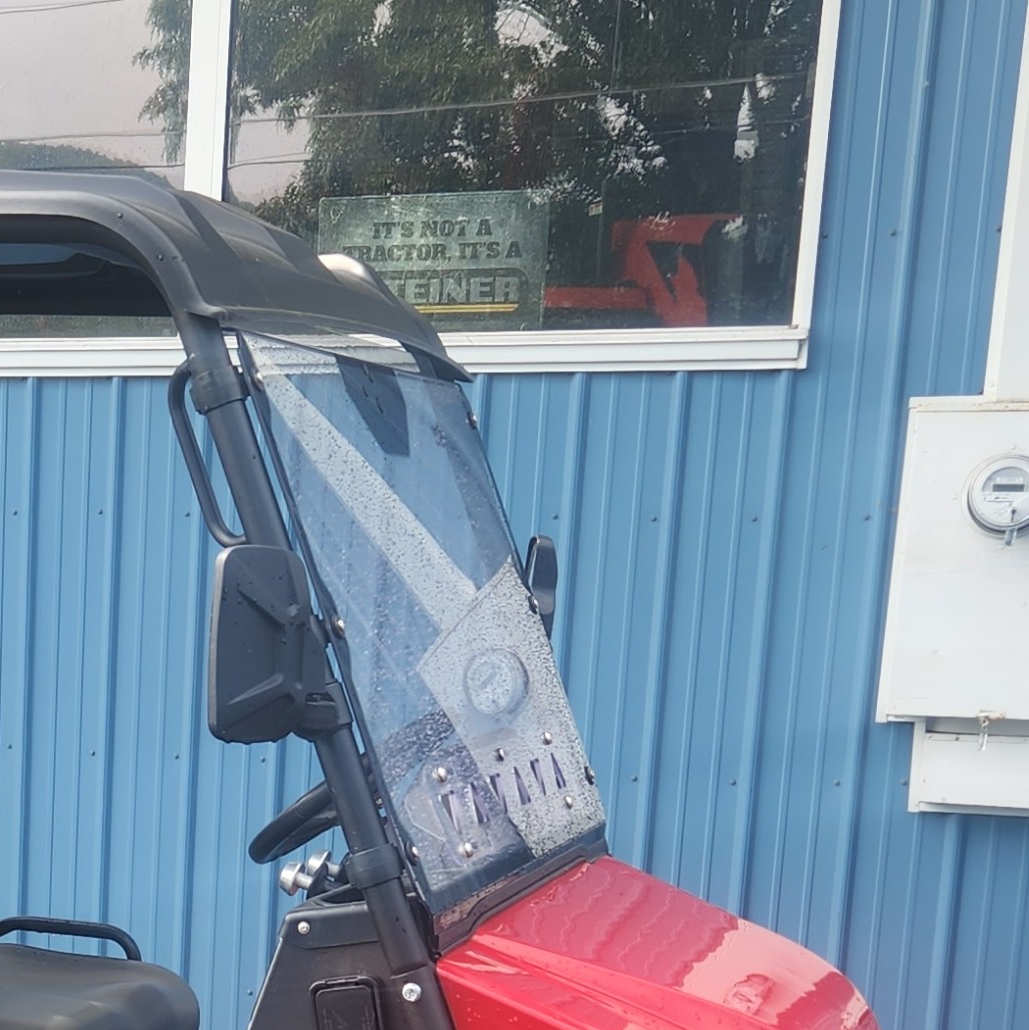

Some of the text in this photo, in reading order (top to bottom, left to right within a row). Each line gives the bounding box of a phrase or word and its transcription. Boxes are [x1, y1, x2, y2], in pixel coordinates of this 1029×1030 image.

[372, 218, 493, 240] IT'S NOT A
[458, 241, 500, 260] IT'S
[505, 240, 523, 259] A
[381, 275, 520, 304] TEINER
